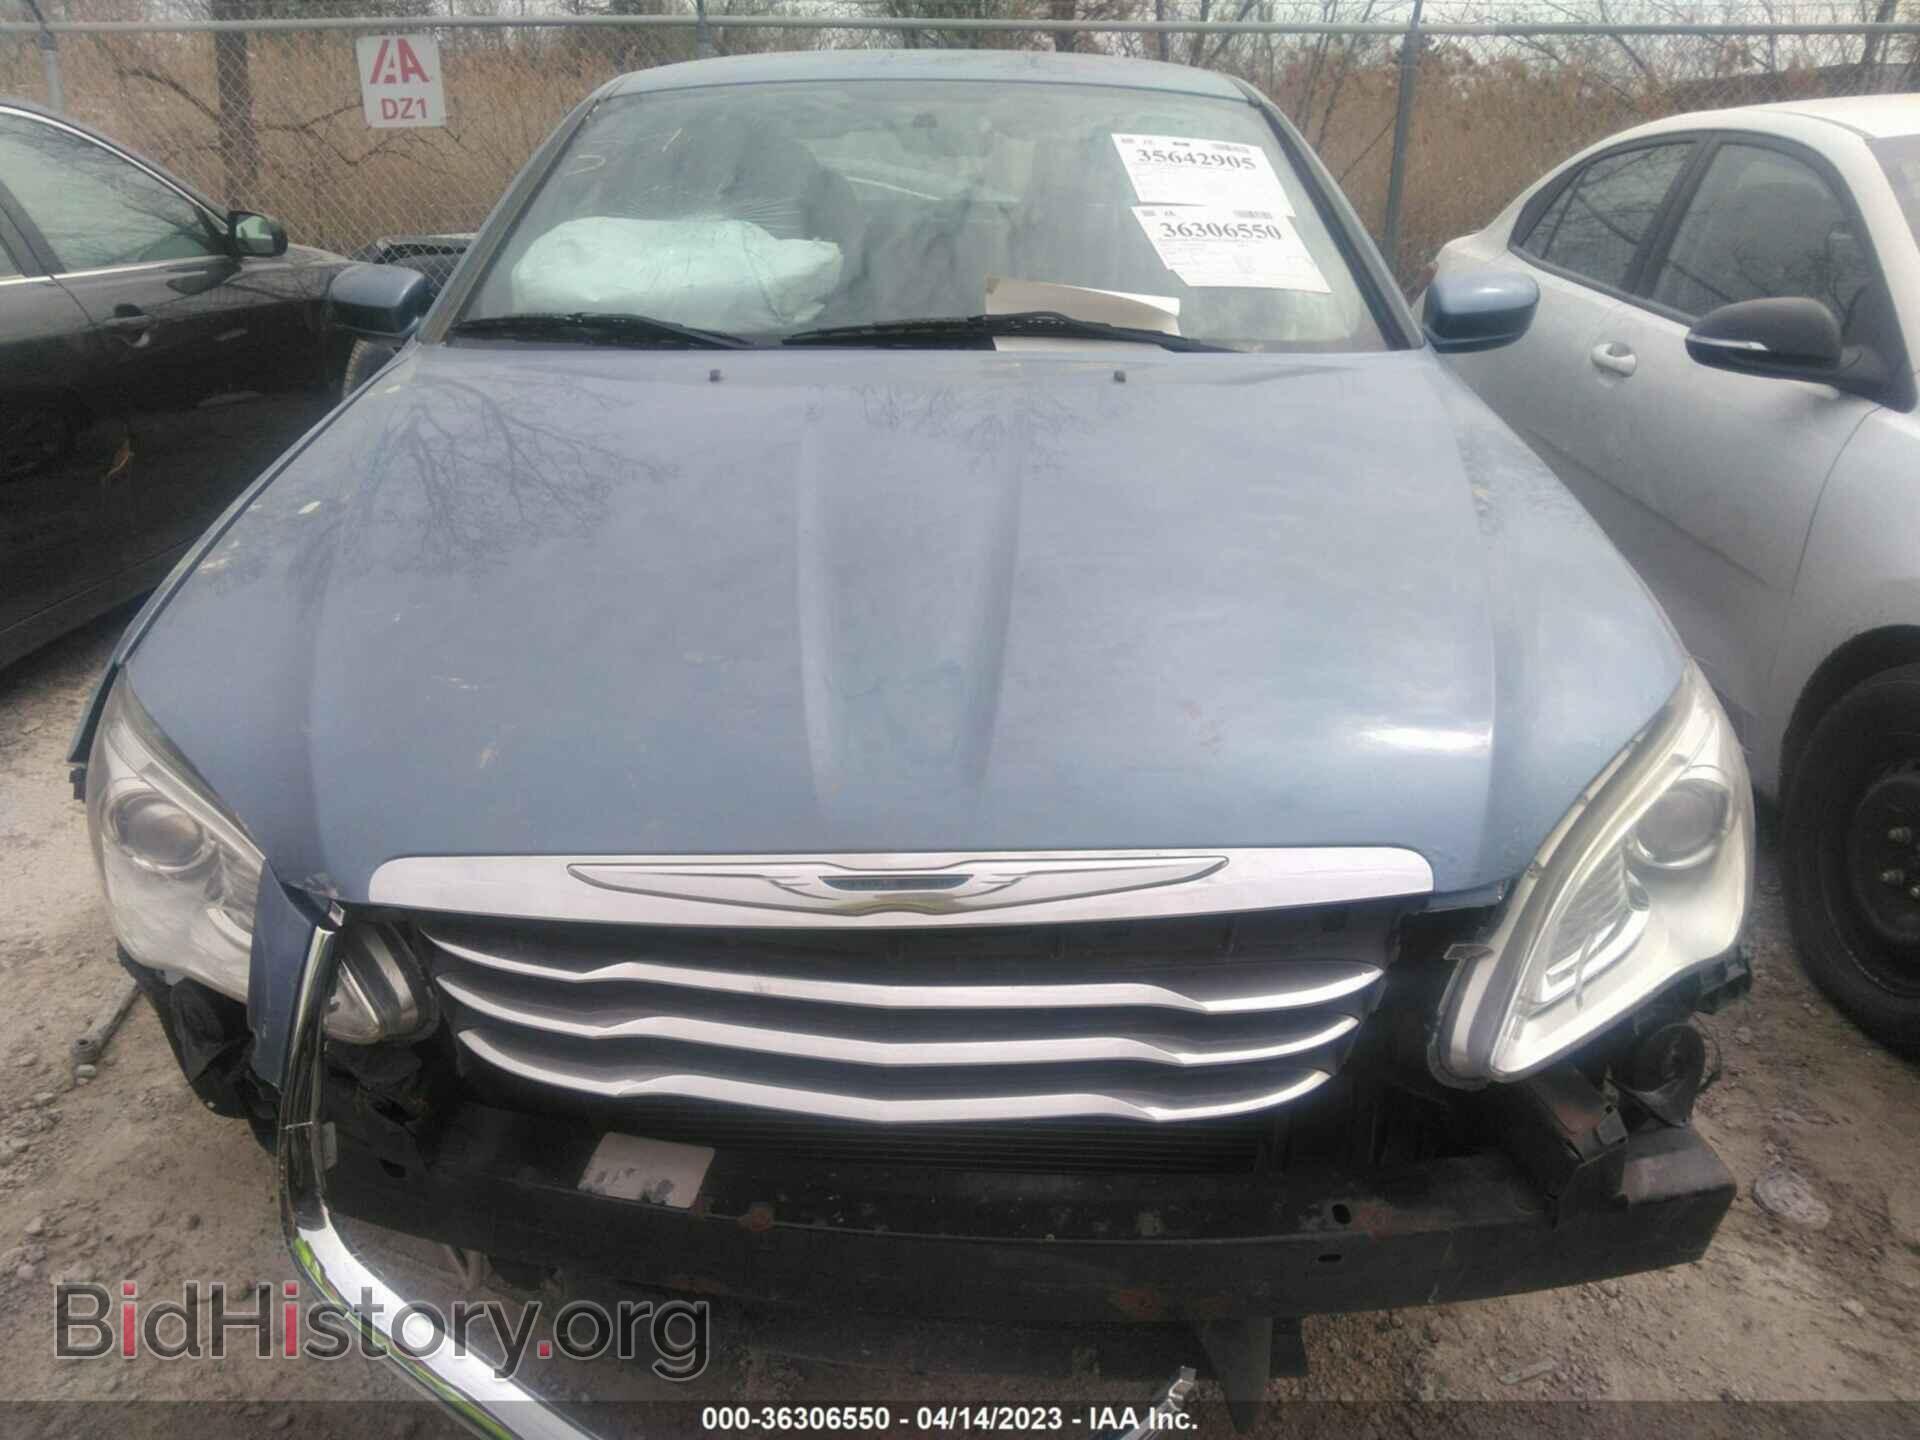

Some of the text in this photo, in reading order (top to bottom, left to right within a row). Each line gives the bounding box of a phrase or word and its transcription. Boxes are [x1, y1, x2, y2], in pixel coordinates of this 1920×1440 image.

[381, 97, 427, 119] DZ1
[1136, 148, 1257, 170] 35642905
[1160, 222, 1282, 240] 36306550
